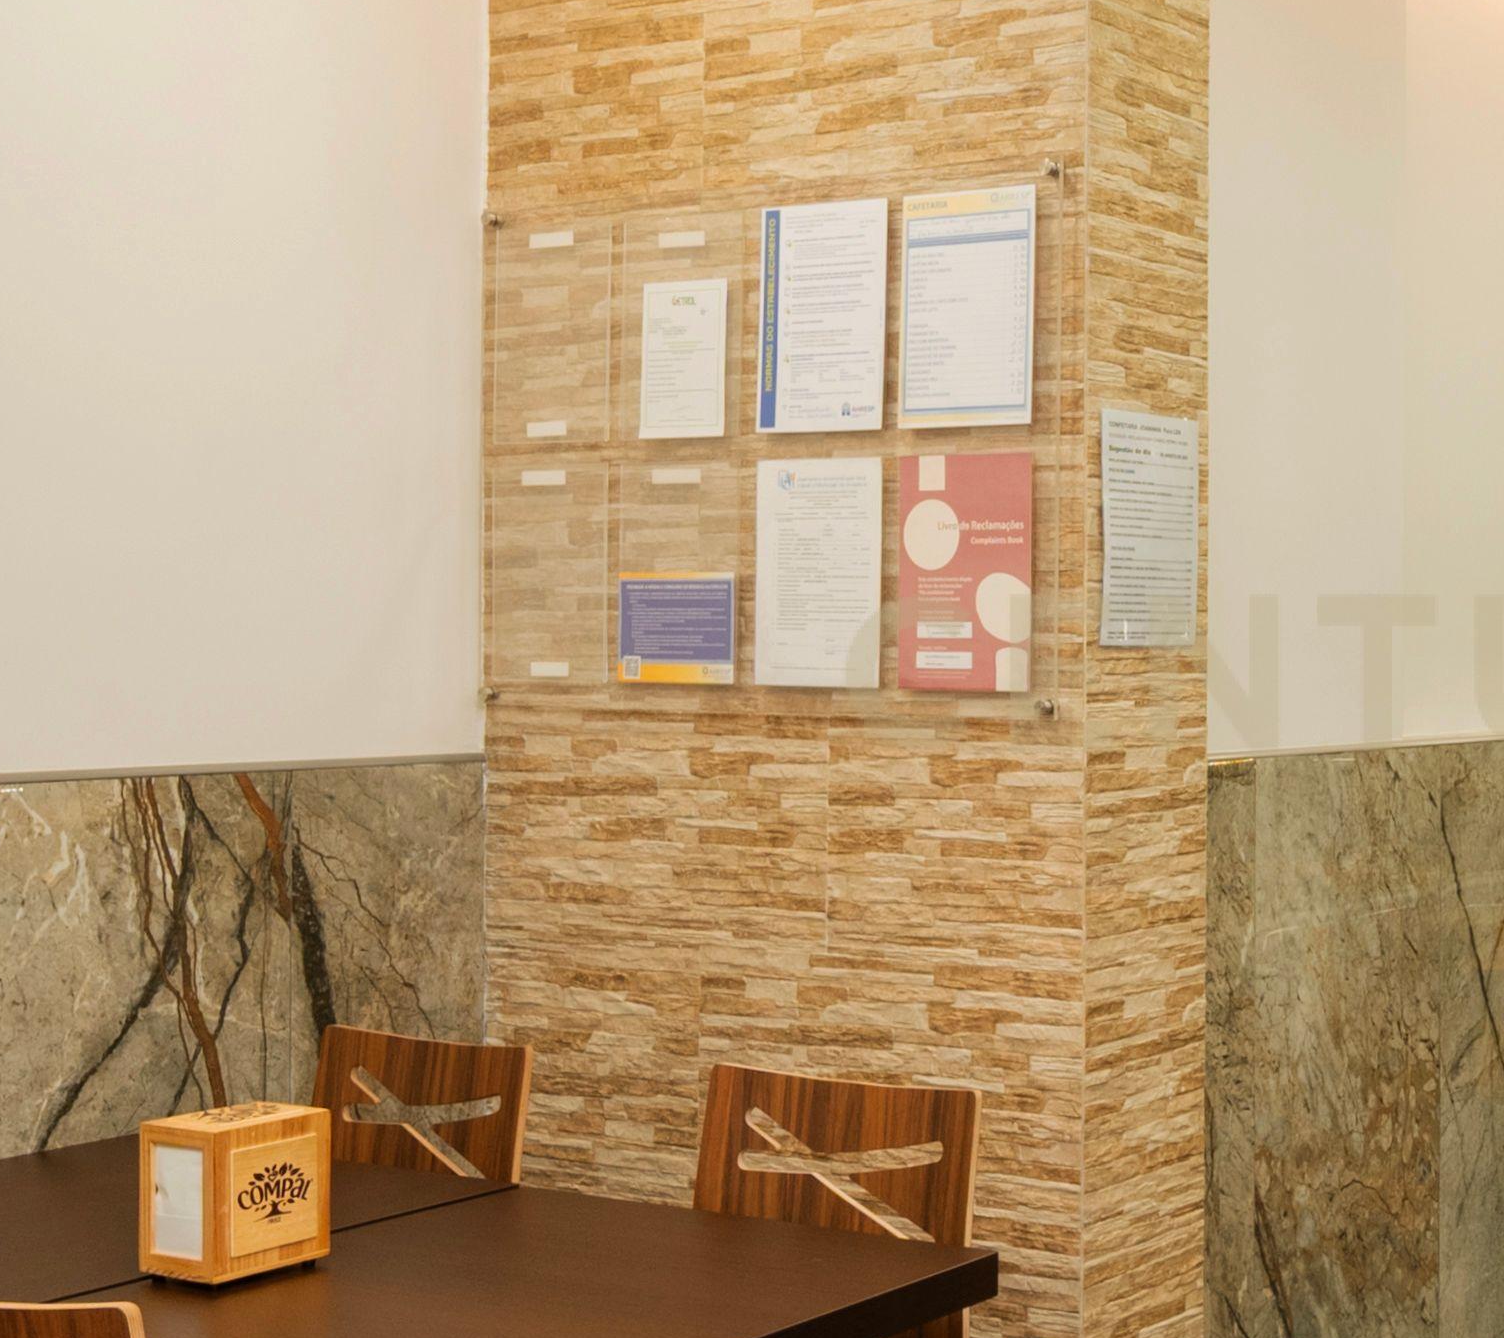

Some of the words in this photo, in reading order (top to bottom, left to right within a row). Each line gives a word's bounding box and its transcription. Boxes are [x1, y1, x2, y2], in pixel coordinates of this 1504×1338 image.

[767, 218, 776, 323] ESTABELECIMENTO
[767, 325, 775, 341] DO
[765, 344, 774, 392] NORMAS
[937, 521, 958, 531] Livro
[971, 520, 1025, 532] Reclamações
[970, 537, 1006, 545] Complaints
[1007, 536, 1024, 544] Book
